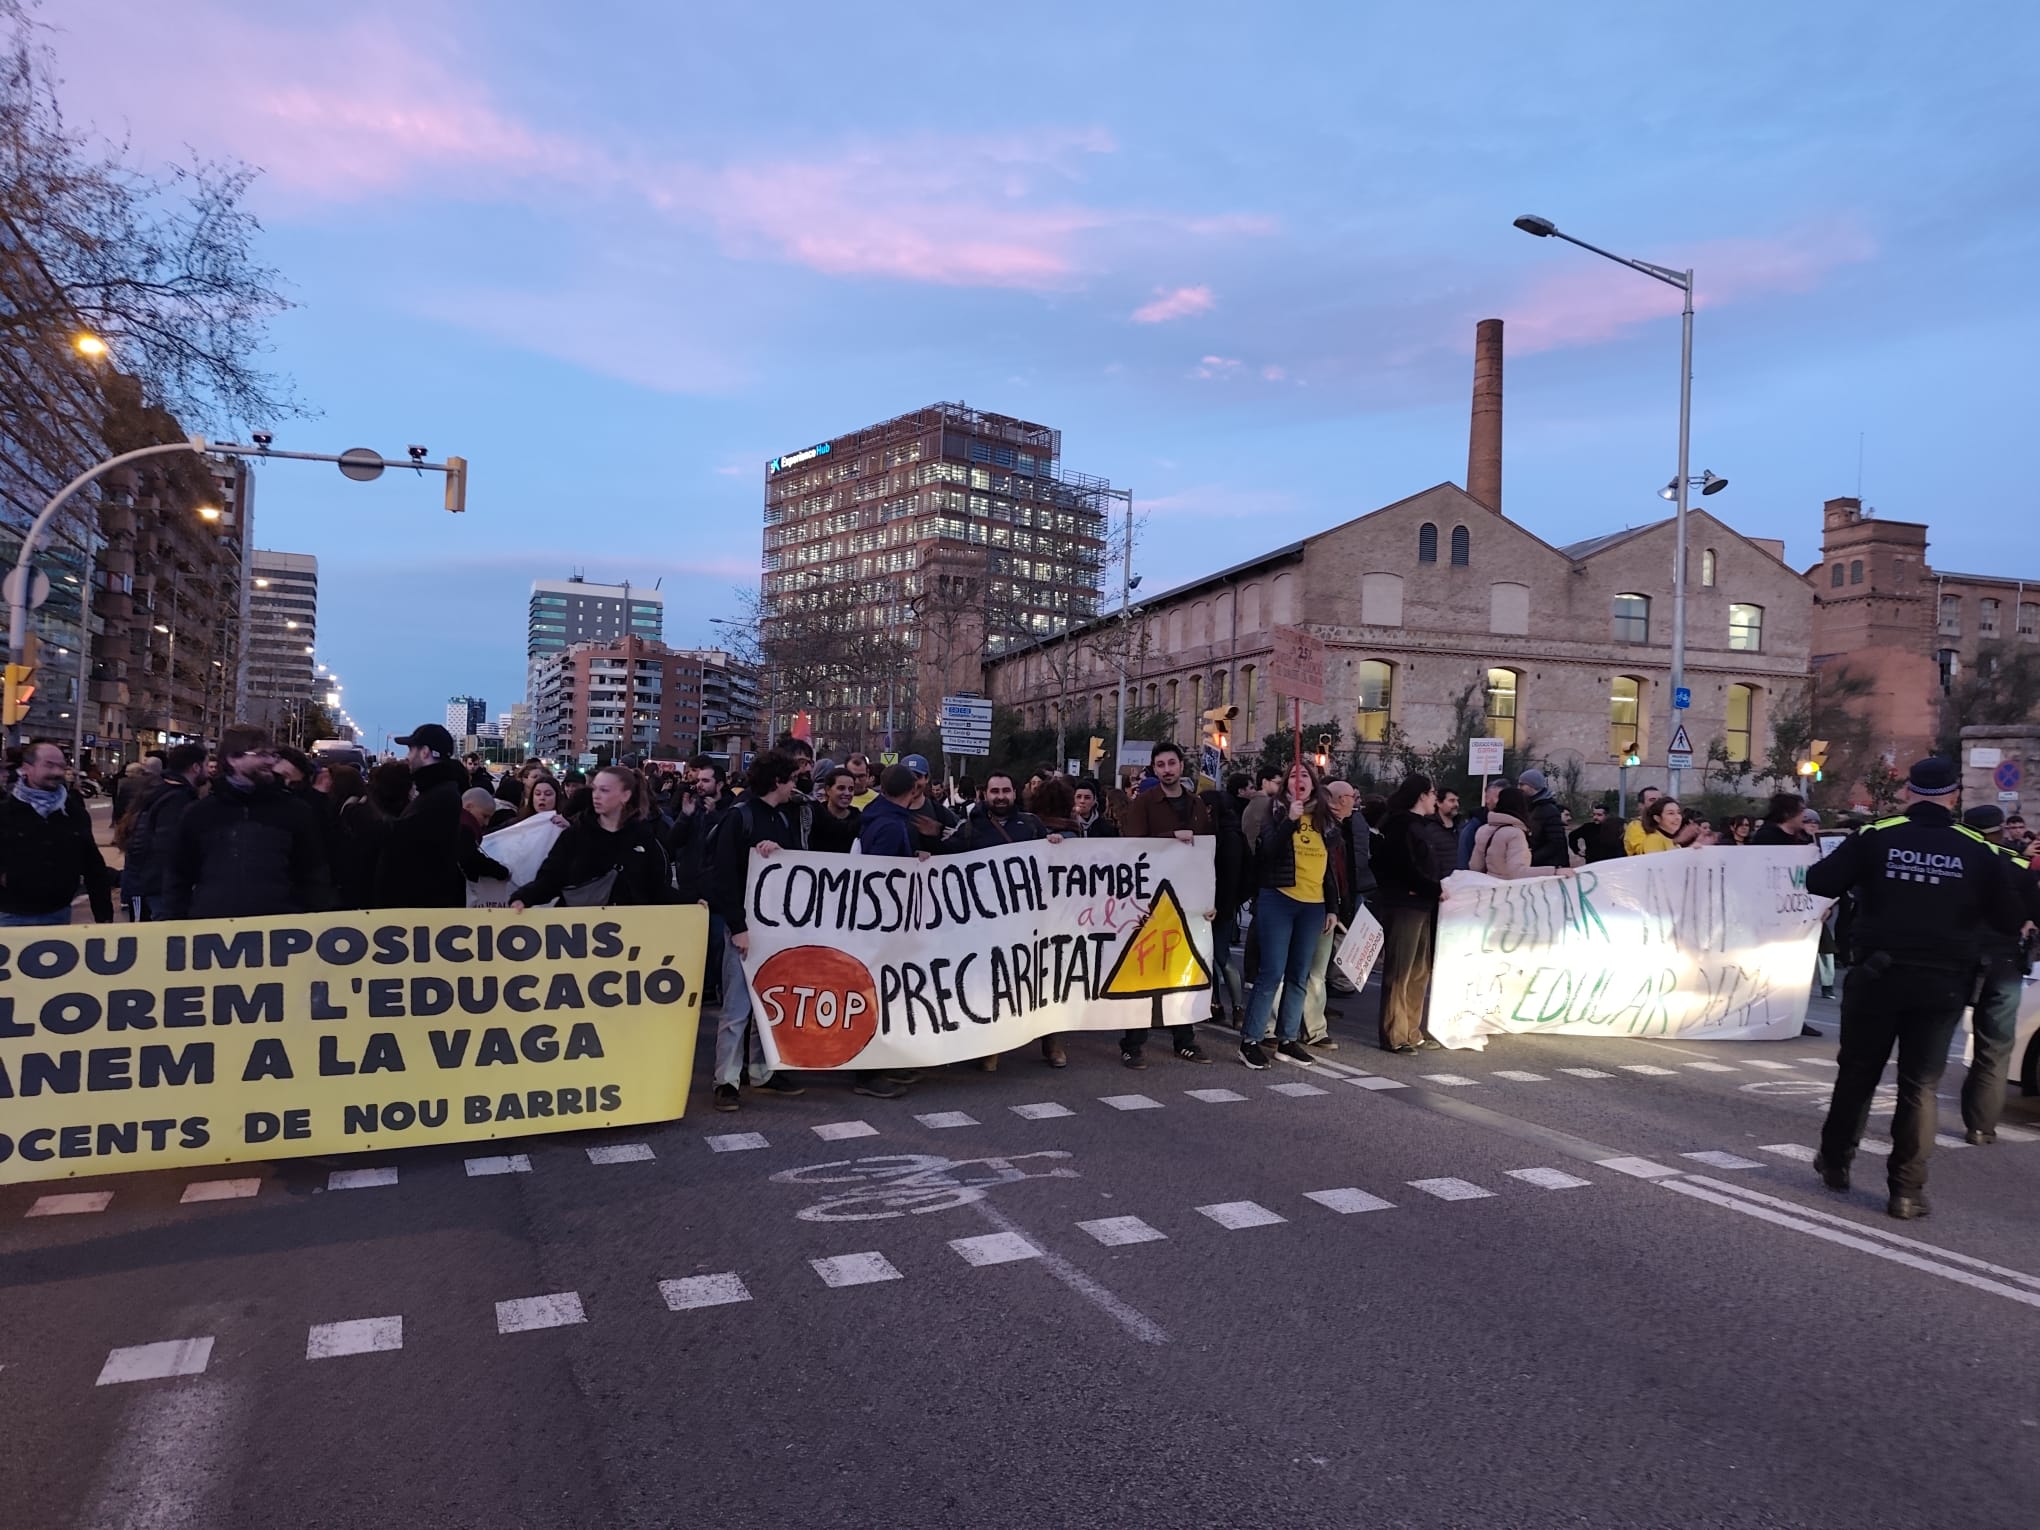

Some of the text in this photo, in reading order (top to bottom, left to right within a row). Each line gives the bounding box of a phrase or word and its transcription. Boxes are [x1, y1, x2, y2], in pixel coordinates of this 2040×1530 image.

[86, 735, 95, 744] P
[1888, 848, 1964, 871] POLICIA
[925, 855, 1049, 931] SOCIAL
[1048, 852, 1152, 900] TAMBÉ
[1077, 907, 1095, 927] a
[165, 921, 641, 972] IMPOSICIONS,
[1132, 928, 1182, 977] FP
[309, 954, 698, 1021] L'EDUCACIÓ,
[761, 984, 868, 1030] STOP
[242, 1037, 295, 1082] A
[318, 1032, 407, 1077] LA
[428, 1022, 605, 1070] VAGA
[244, 1108, 312, 1144] DE
[343, 1099, 449, 1135] NOU
[463, 1084, 622, 1125] BARRIS
